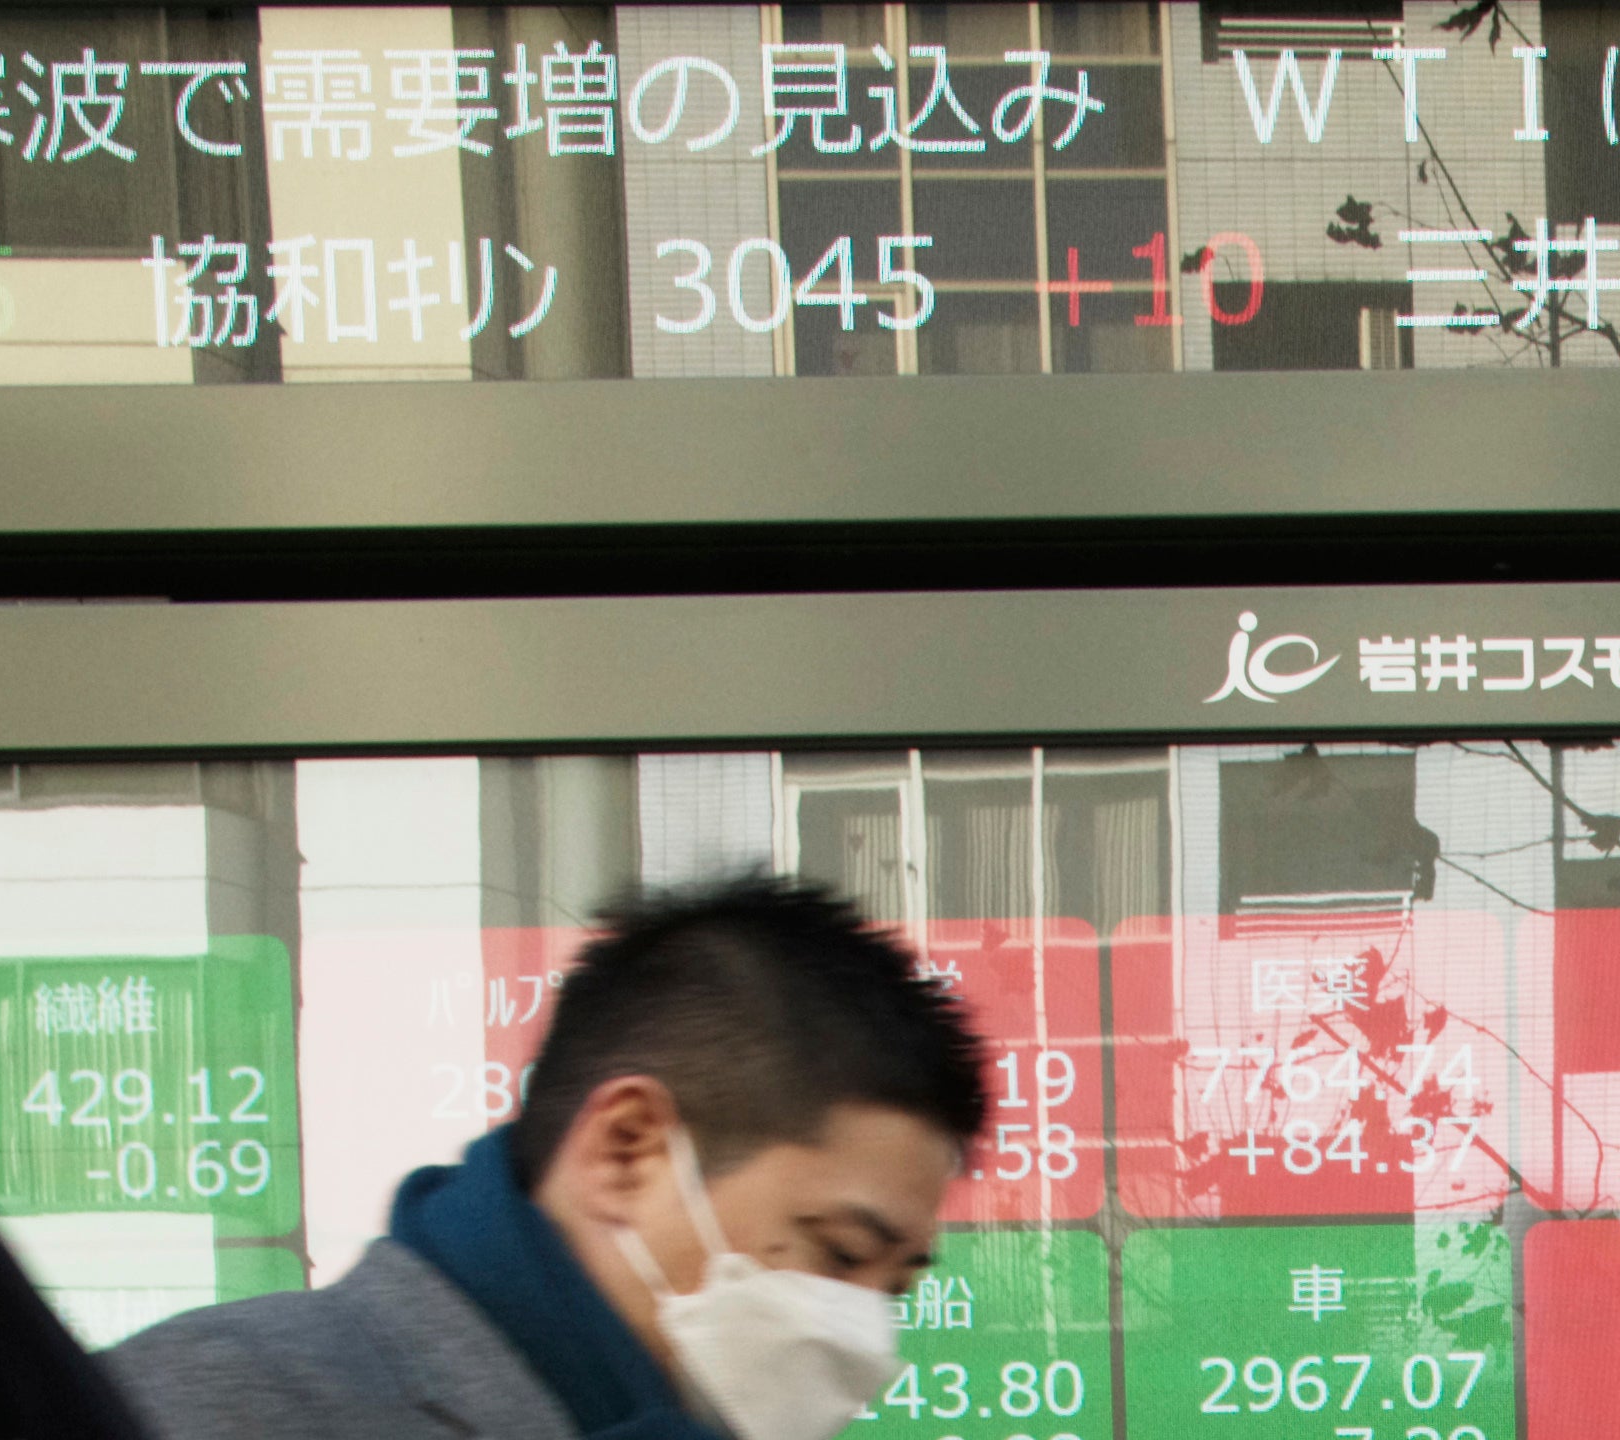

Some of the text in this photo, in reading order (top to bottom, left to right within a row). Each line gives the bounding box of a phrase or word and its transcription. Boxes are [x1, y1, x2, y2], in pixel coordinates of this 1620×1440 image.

[141, 234, 558, 348] 協和キリン
[655, 234, 935, 334] 3045
[1037, 231, 1265, 328] +10
[34, 974, 158, 1036] 繊維
[1251, 954, 1370, 1014] 医薬
[21, 1067, 269, 1128] 429.12
[1189, 1042, 1482, 1104] 7764.74
[86, 1140, 272, 1199] -0.69
[1227, 1115, 1481, 1176] +84.37
[1287, 1264, 1347, 1322] 車
[1198, 1351, 1487, 1414] 2967.07
